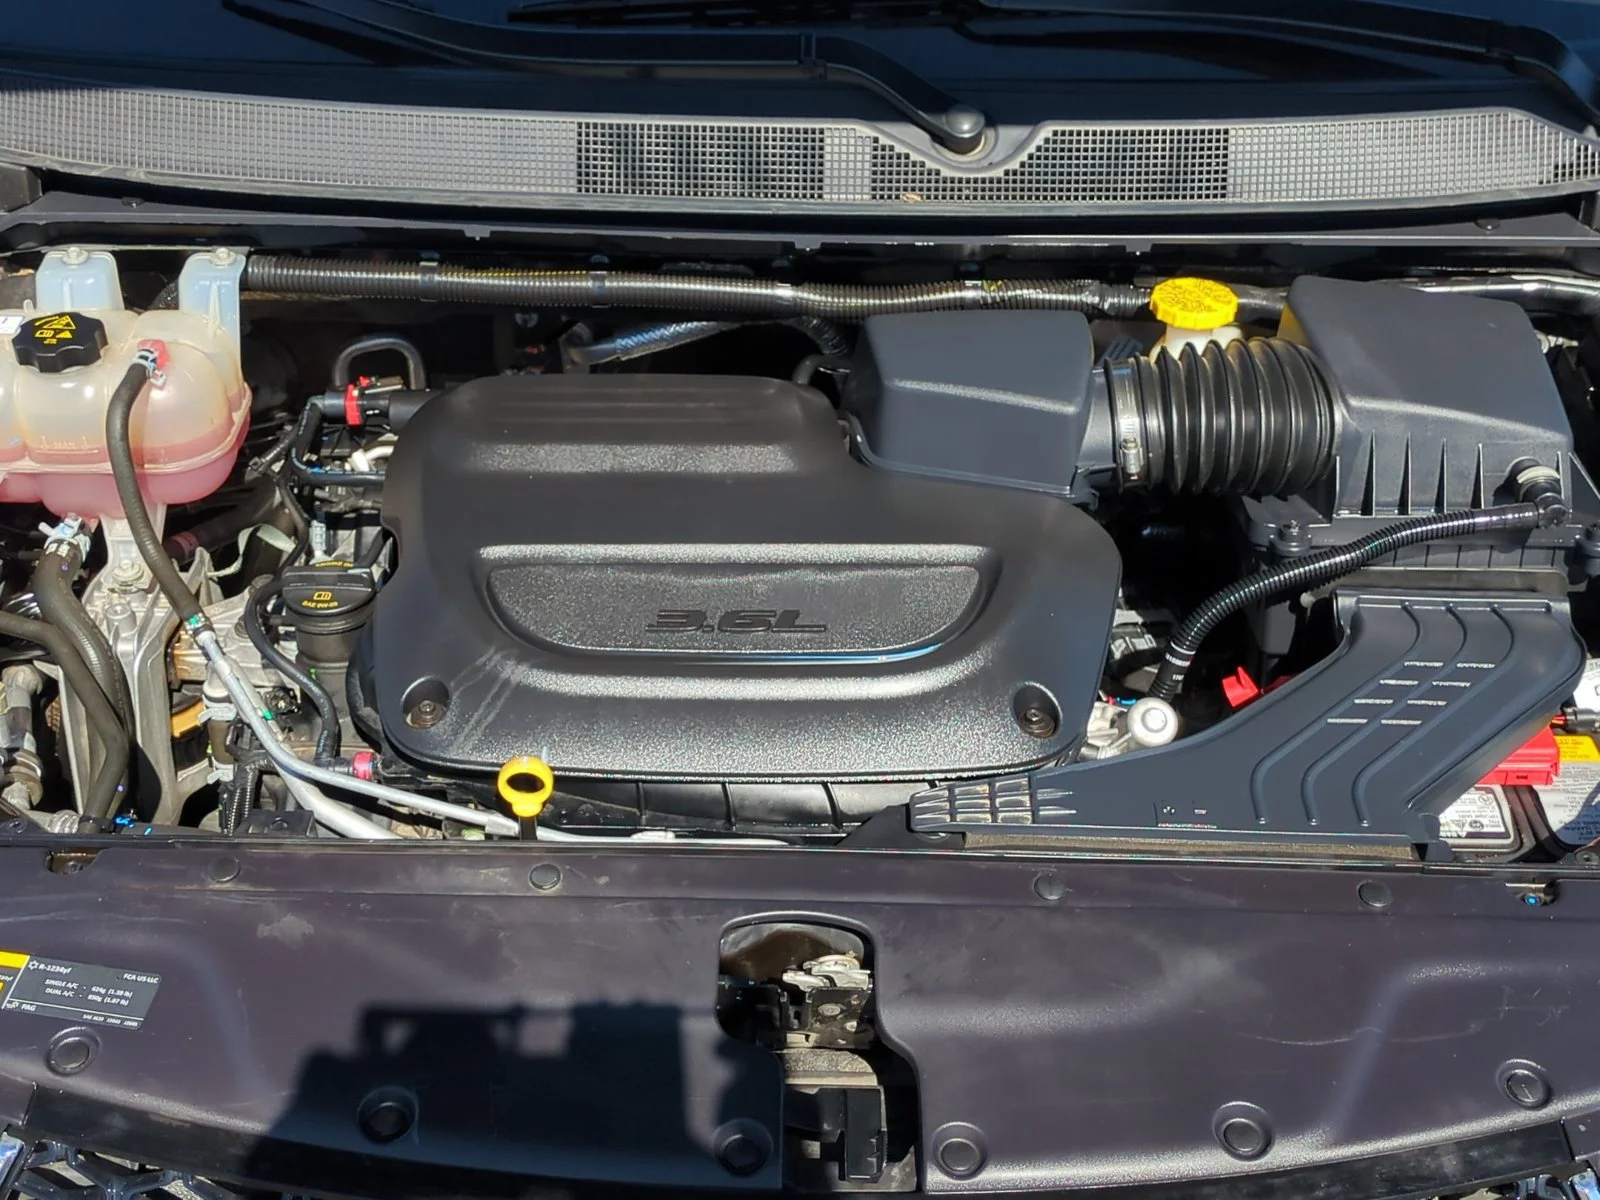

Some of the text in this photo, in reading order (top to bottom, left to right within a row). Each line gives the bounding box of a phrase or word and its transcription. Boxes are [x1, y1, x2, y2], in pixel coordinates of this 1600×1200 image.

[645, 610, 827, 632] 3.6L
[38, 963, 72, 974] R-1234yf
[123, 973, 136, 981] FCA
[45, 979, 66, 987] SINGLE
[62, 990, 75, 998] A/C
[21, 1003, 37, 1011] PAG
